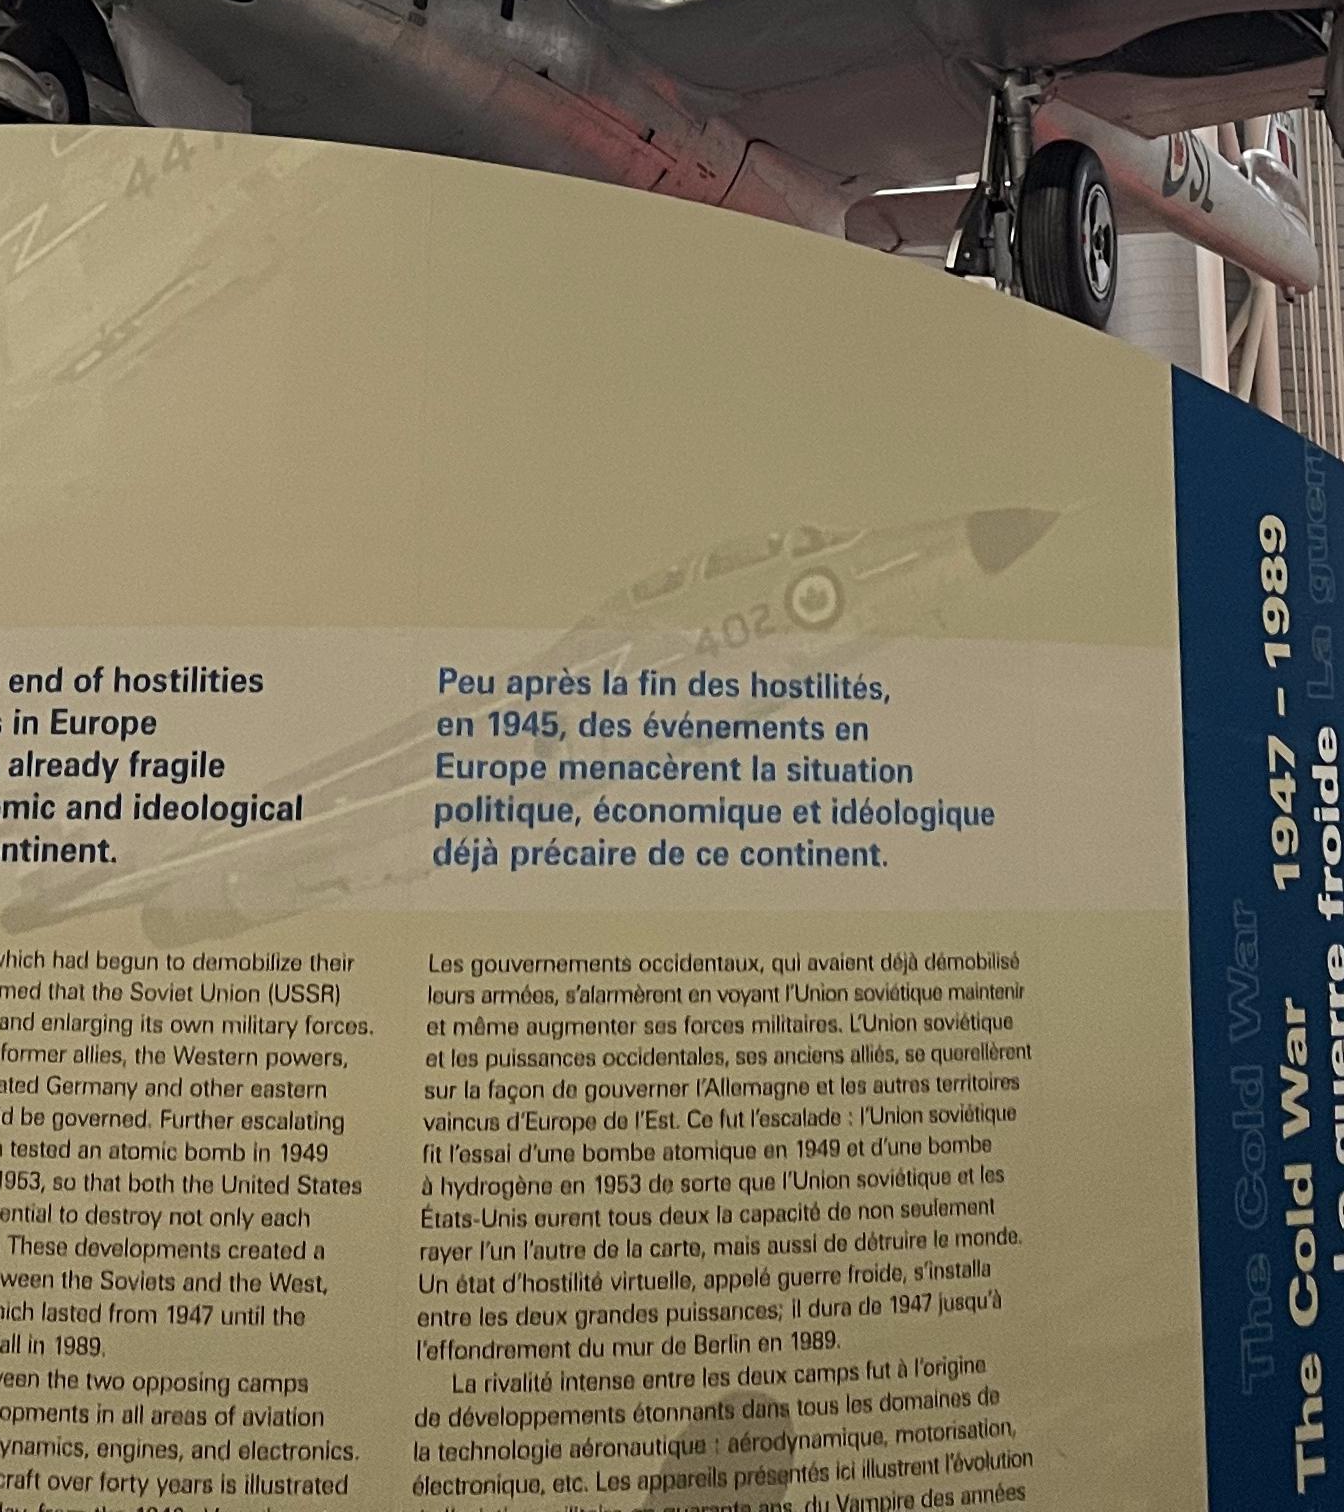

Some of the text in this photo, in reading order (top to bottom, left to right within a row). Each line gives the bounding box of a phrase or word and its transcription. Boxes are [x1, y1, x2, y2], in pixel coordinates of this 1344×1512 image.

[1258, 514, 1292, 669] 1989
[694, 604, 778, 657] 402
[7, 666, 65, 694] end
[72, 665, 107, 694] of
[112, 665, 265, 694] hostilities
[1307, 625, 1335, 699] La
[438, 667, 891, 705] Peu après la fin des hostilités,
[11, 707, 41, 735] in
[48, 707, 159, 743] Europe
[436, 710, 870, 742] en 1945, des événements en
[6, 749, 121, 785] already
[127, 750, 227, 785] fragile
[434, 752, 914, 787] Europe menacèrent la situation
[64, 792, 124, 821] and
[132, 792, 304, 829] ideological
[432, 795, 997, 833] politique, économique et idéologique
[1267, 734, 1301, 891] 1947
[1311, 726, 1344, 922] froide
[431, 838, 889, 873] déjà précaire de ce continent.
[51, 950, 90, 971] had
[95, 951, 160, 975] begun
[165, 953, 187, 972] to
[191, 952, 304, 973] demobilize
[308, 953, 356, 974] their
[427, 950, 1021, 979] Les gouvernements occidentaux, qui avaient déjà démobilisé
[0, 1043, 69, 1064] former
[72, 1045, 128, 1070] allies,
[134, 1046, 167, 1066] the
[172, 1046, 259, 1068] Western
[264, 1050, 349, 1072] powers,
[424, 1041, 1033, 1073] et les puissances occidentales, ses anciens alliés, se querellèrent
[1280, 997, 1311, 1139] War
[19, 1107, 46, 1127] be
[51, 1110, 153, 1132] governed.
[159, 1110, 235, 1132] Further
[240, 1112, 346, 1136] escalating
[1227, 897, 1276, 1395] The Cold War
[419, 1197, 996, 1230] États-Unis eurent tous deux la capacité de non seulement
[1284, 1163, 1319, 1327] Cold
[46, 1370, 80, 1391] the
[85, 1371, 126, 1392] two
[131, 1373, 231, 1397] opposing
[236, 1377, 310, 1398] camps
[95, 1405, 116, 1425] in
[120, 1406, 145, 1426] all
[149, 1408, 209, 1427] areas
[213, 1407, 238, 1427] of
[241, 1407, 326, 1428] aviation
[413, 1386, 1001, 1431] de développements étonnants dans tous les domaines de
[1295, 1352, 1326, 1495] The
[46, 1473, 95, 1494] over
[98, 1473, 151, 1498] forty
[155, 1476, 215, 1499] years
[219, 1476, 238, 1496] is
[243, 1476, 350, 1497] illustrated
